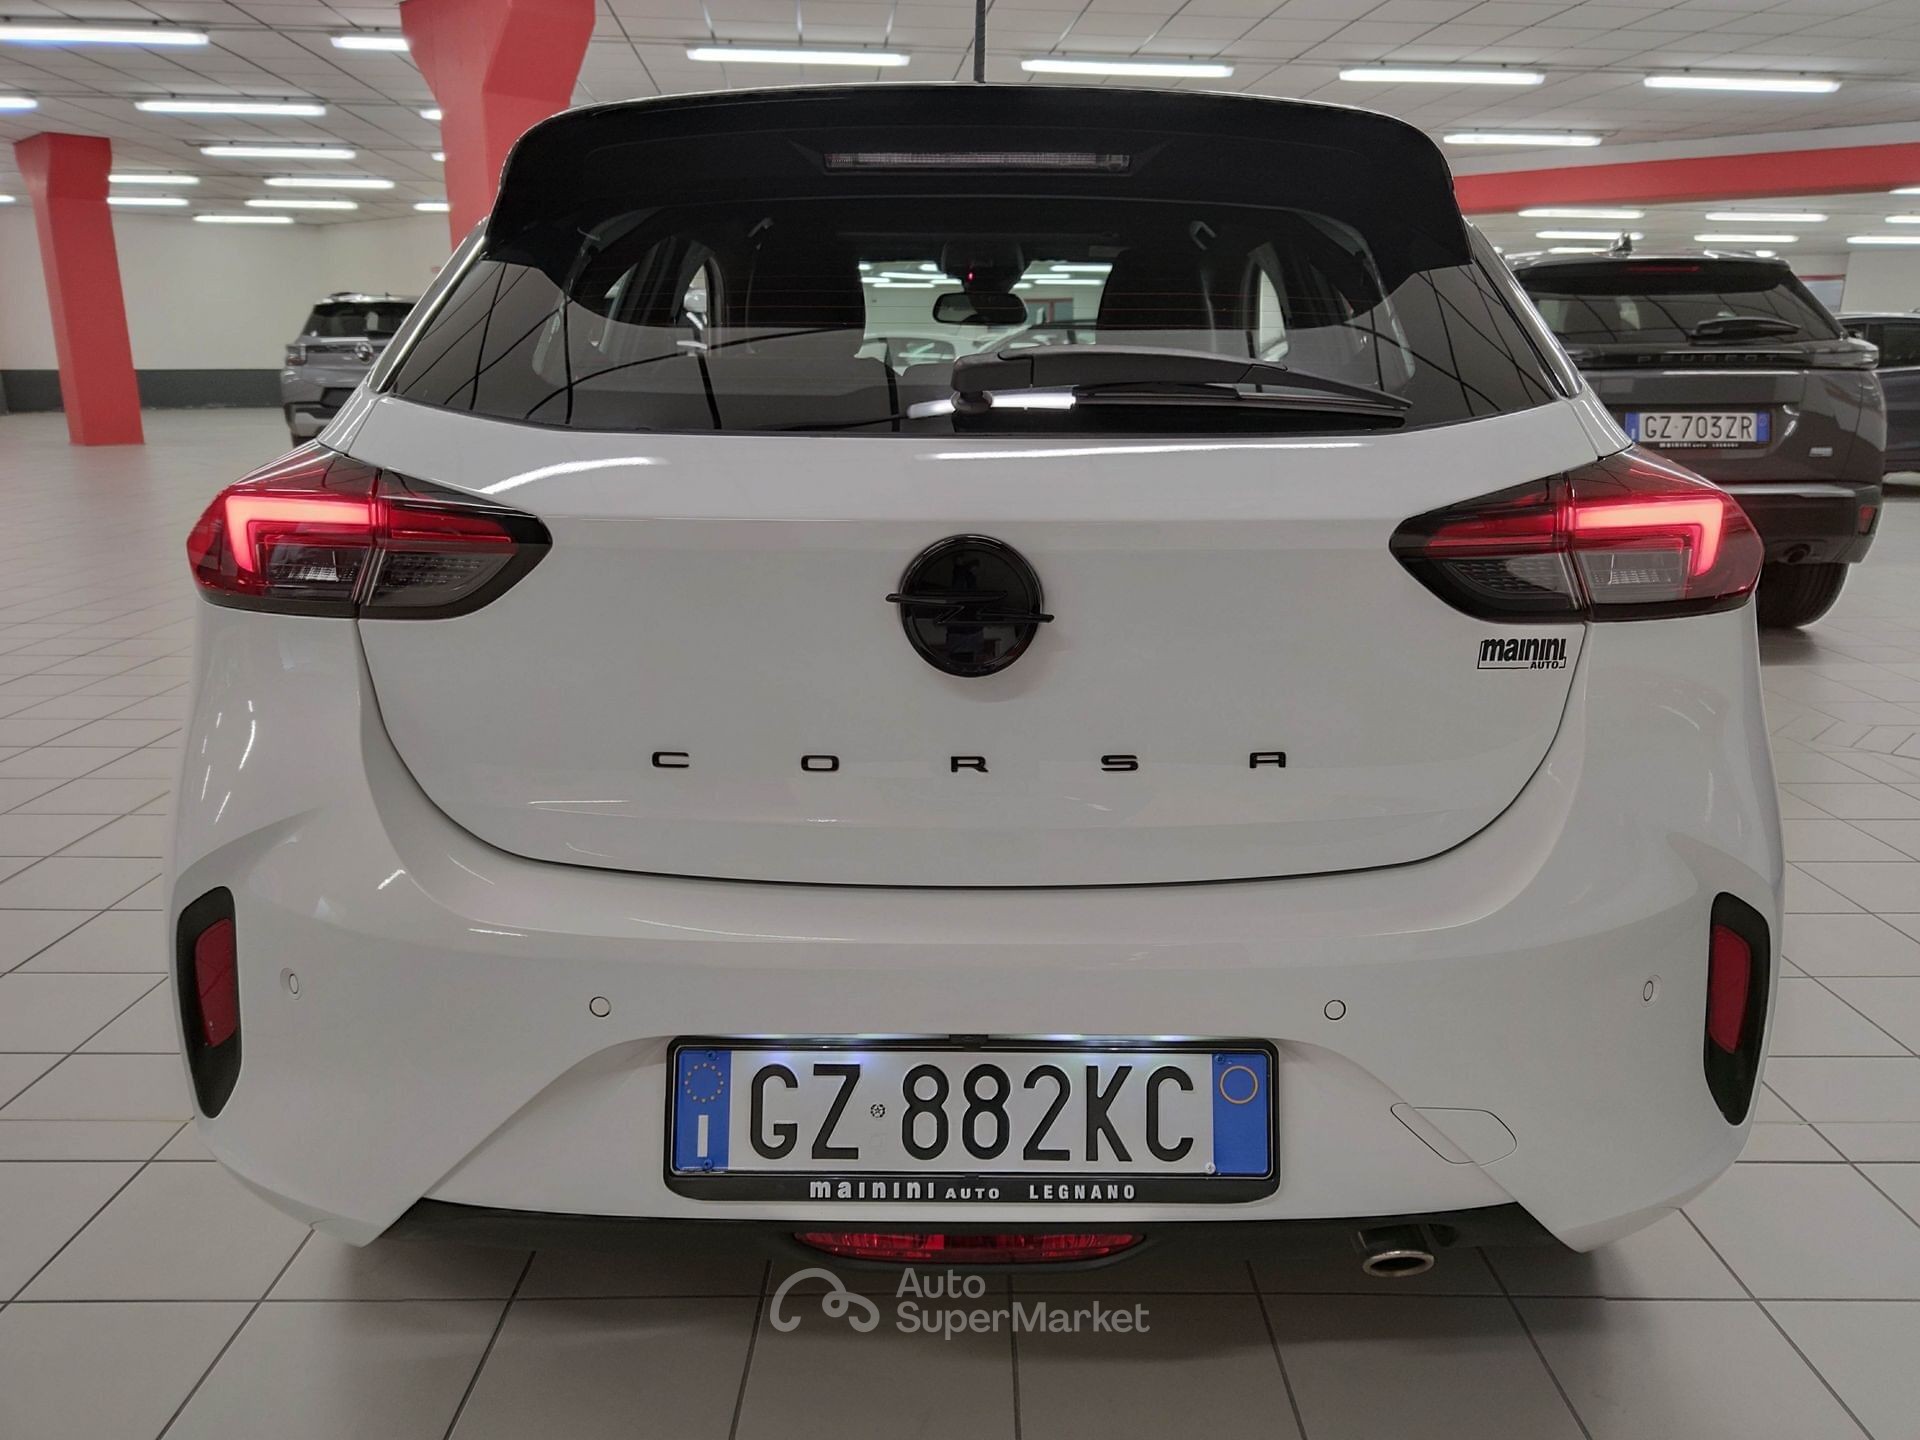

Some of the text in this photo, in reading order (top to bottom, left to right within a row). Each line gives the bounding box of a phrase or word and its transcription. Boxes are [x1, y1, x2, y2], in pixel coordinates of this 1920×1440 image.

[1645, 416, 1672, 439] GZ
[1680, 416, 1753, 439] 703ZR
[1529, 660, 1559, 669] AUTO
[651, 750, 1287, 774] CORSA
[750, 1064, 861, 1160] GZ
[902, 1064, 1194, 1162] 882KC
[809, 1180, 1135, 1199] mainini AUTO LEGNANO
